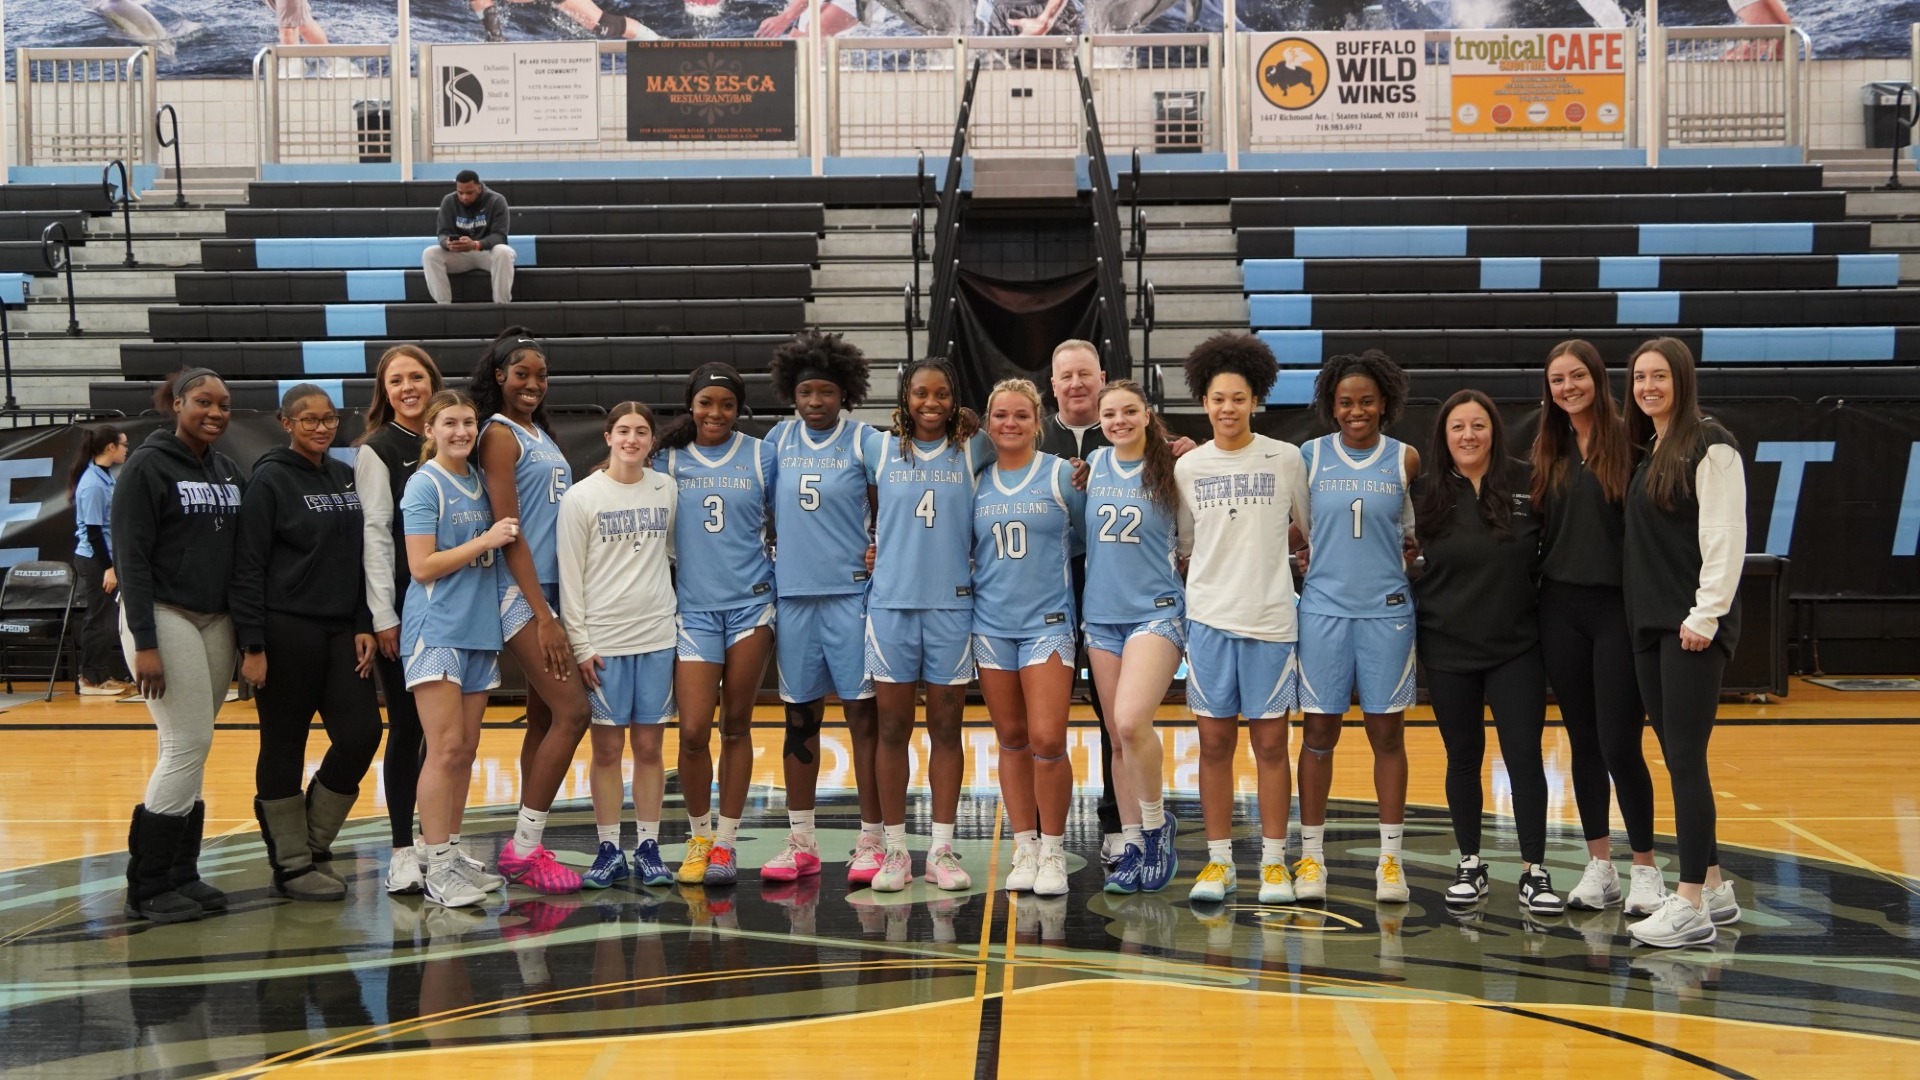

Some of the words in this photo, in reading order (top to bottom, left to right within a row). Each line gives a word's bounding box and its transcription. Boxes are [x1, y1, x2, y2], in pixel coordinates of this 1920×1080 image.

[1336, 40, 1416, 56] BUFFALO
[1454, 33, 1545, 65] tropical
[1547, 33, 1623, 71] CAFE
[1336, 57, 1417, 83] WILD
[646, 75, 710, 92] MAX'S
[715, 75, 776, 92] ES-CA
[670, 93, 752, 103] RESTAURANT/BAR
[1338, 84, 1417, 104] WINGS
[1279, 113, 1313, 121] Richmond
[1315, 113, 1328, 121] Ave.
[1336, 112, 1359, 120] Staten
[1360, 112, 1383, 121] Island,
[781, 457, 814, 469] STATEN
[817, 457, 849, 469] ISLAND
[679, 476, 714, 491] STATEN
[718, 476, 752, 490] ISLAND
[889, 469, 927, 483] STATEN
[930, 470, 963, 484] ISLAND
[548, 466, 567, 505] 15
[799, 473, 822, 512] 5
[1319, 479, 1359, 492] STATEN
[1363, 480, 1397, 495] ISLAND
[1090, 486, 1124, 498] STATEN
[1126, 488, 1159, 502] ISLAN
[914, 489, 936, 529] 4
[1013, 502, 1048, 514] ISLAND
[1198, 497, 1272, 510] BASKETBALL
[702, 494, 725, 534] 3
[1350, 497, 1364, 539] 1
[1097, 503, 1143, 545] 22
[991, 520, 1027, 560] 10
[42, 569, 67, 577] ISLAND
